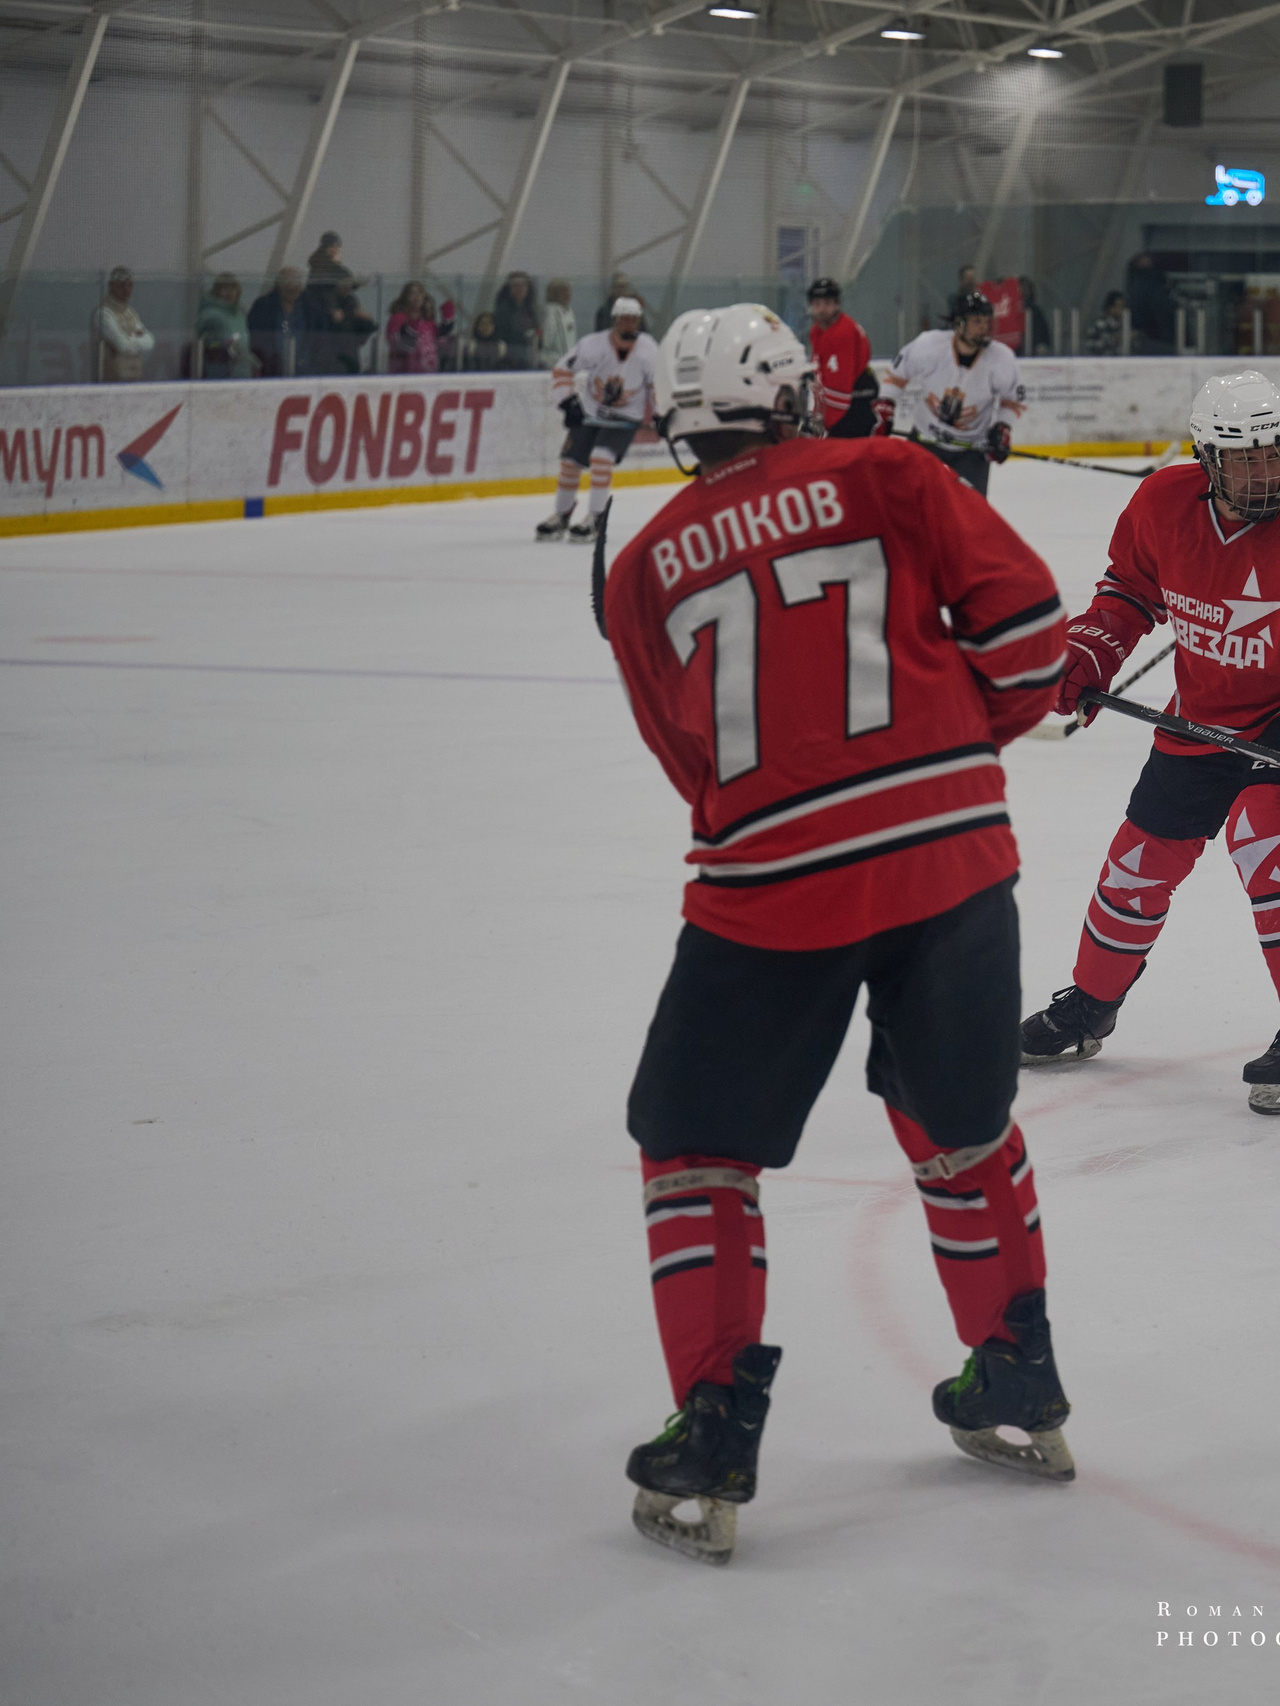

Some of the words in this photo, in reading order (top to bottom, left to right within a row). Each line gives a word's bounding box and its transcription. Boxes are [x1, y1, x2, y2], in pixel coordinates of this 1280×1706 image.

[266, 389, 496, 488] FONBET
[1250, 421, 1280, 432] CCM
[651, 479, 844, 591] ВОЛКОВ
[664, 537, 892, 788] 77
